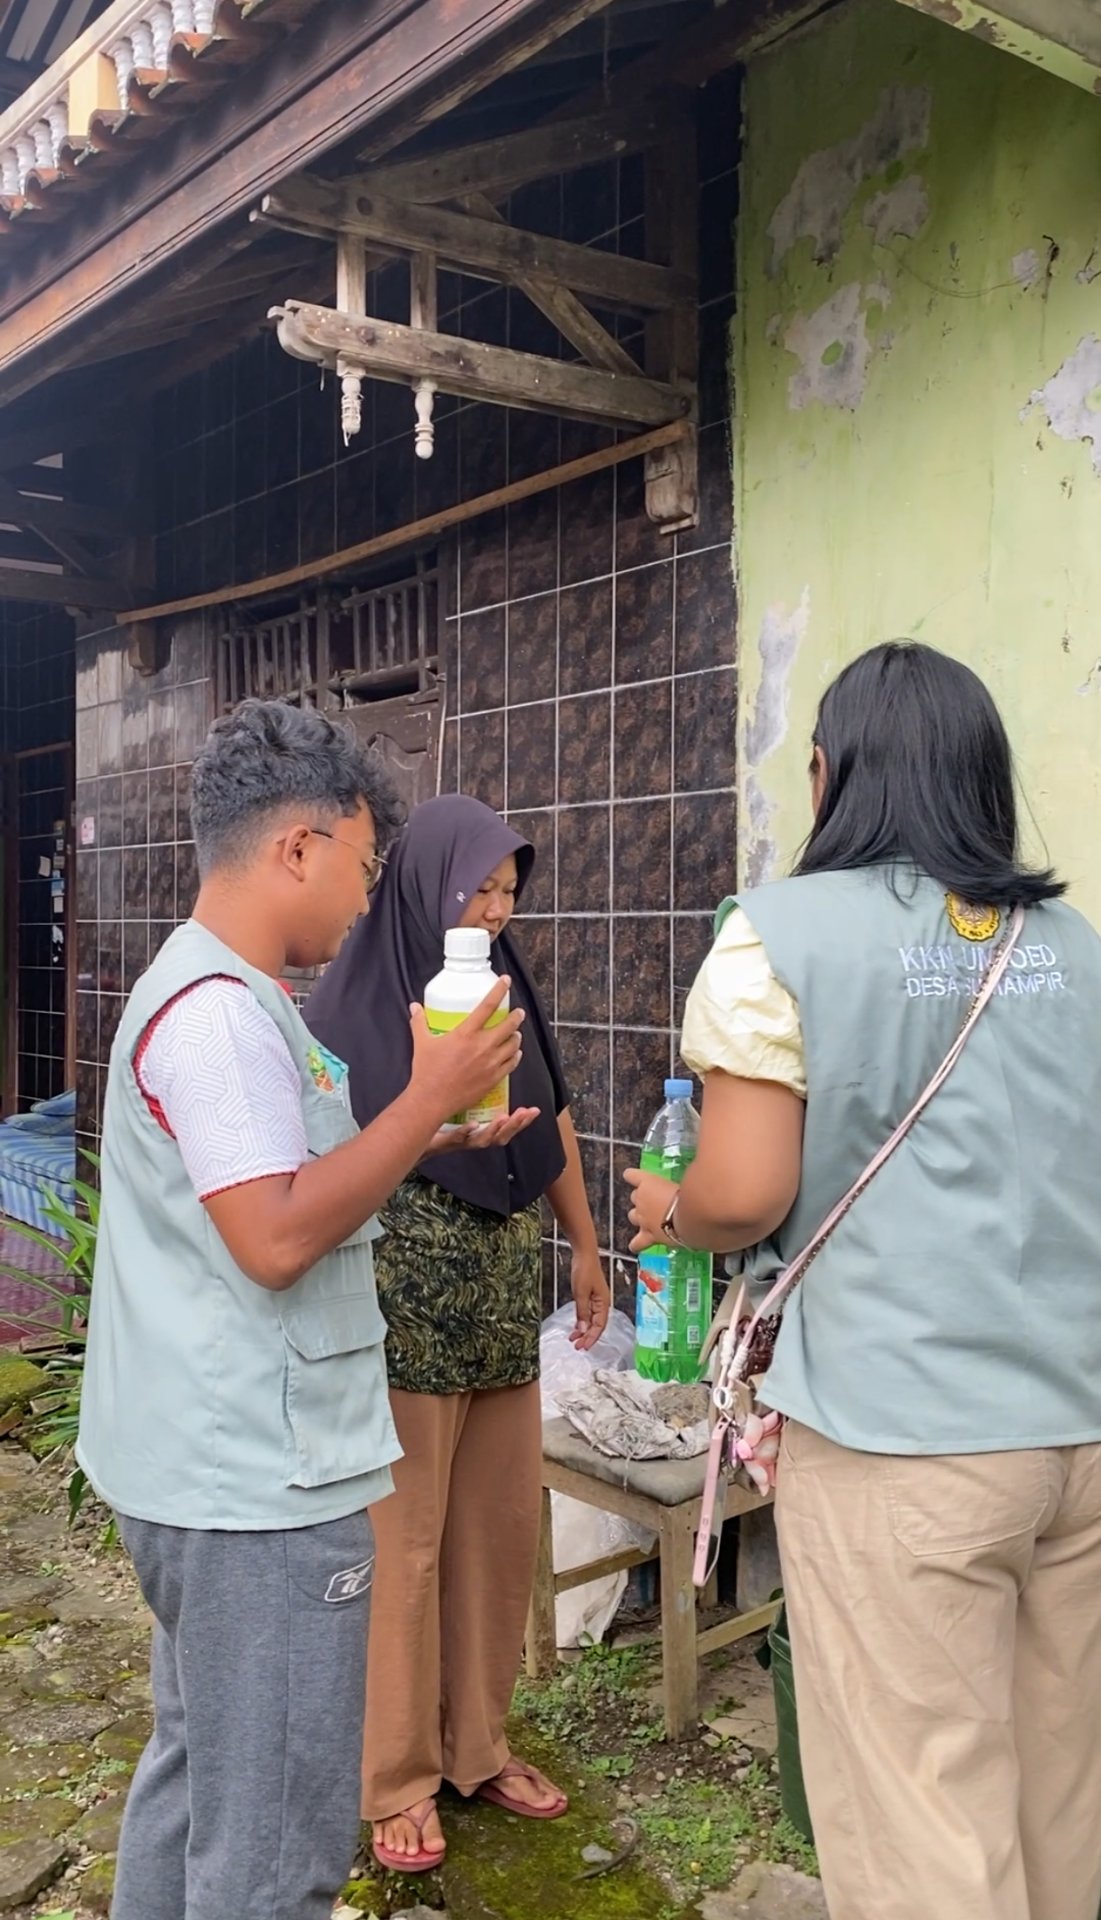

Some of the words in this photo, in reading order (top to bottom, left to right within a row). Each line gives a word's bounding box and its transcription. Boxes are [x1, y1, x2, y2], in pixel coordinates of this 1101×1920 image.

[899, 945, 954, 972] KKN
[961, 944, 1056, 972] UNOED
[906, 976, 960, 997] DESA
